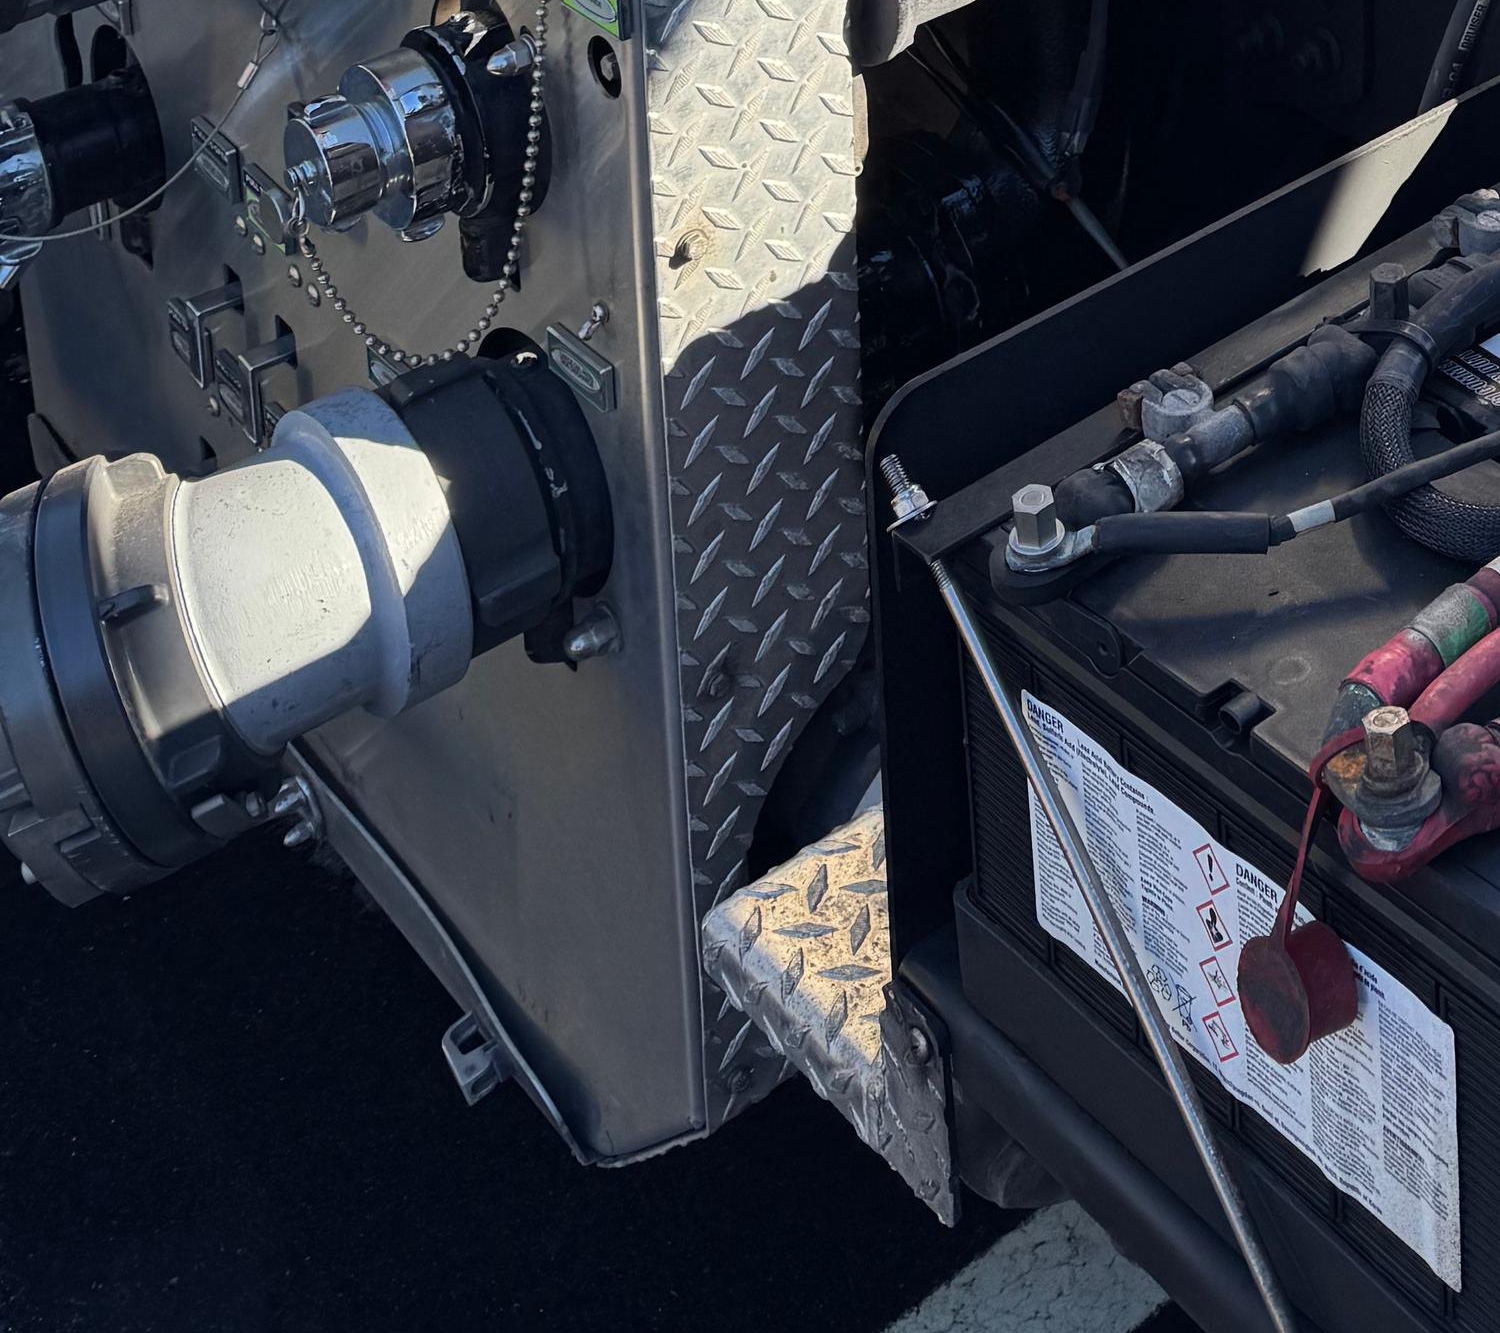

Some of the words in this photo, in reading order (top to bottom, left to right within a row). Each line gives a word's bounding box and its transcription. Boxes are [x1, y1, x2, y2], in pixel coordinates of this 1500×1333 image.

[1026, 697, 1064, 733] DANGER
[1077, 738, 1089, 754] Lead
[1091, 749, 1102, 764] Acid
[1120, 777, 1144, 800] Contains
[1235, 862, 1278, 904] DANGER
